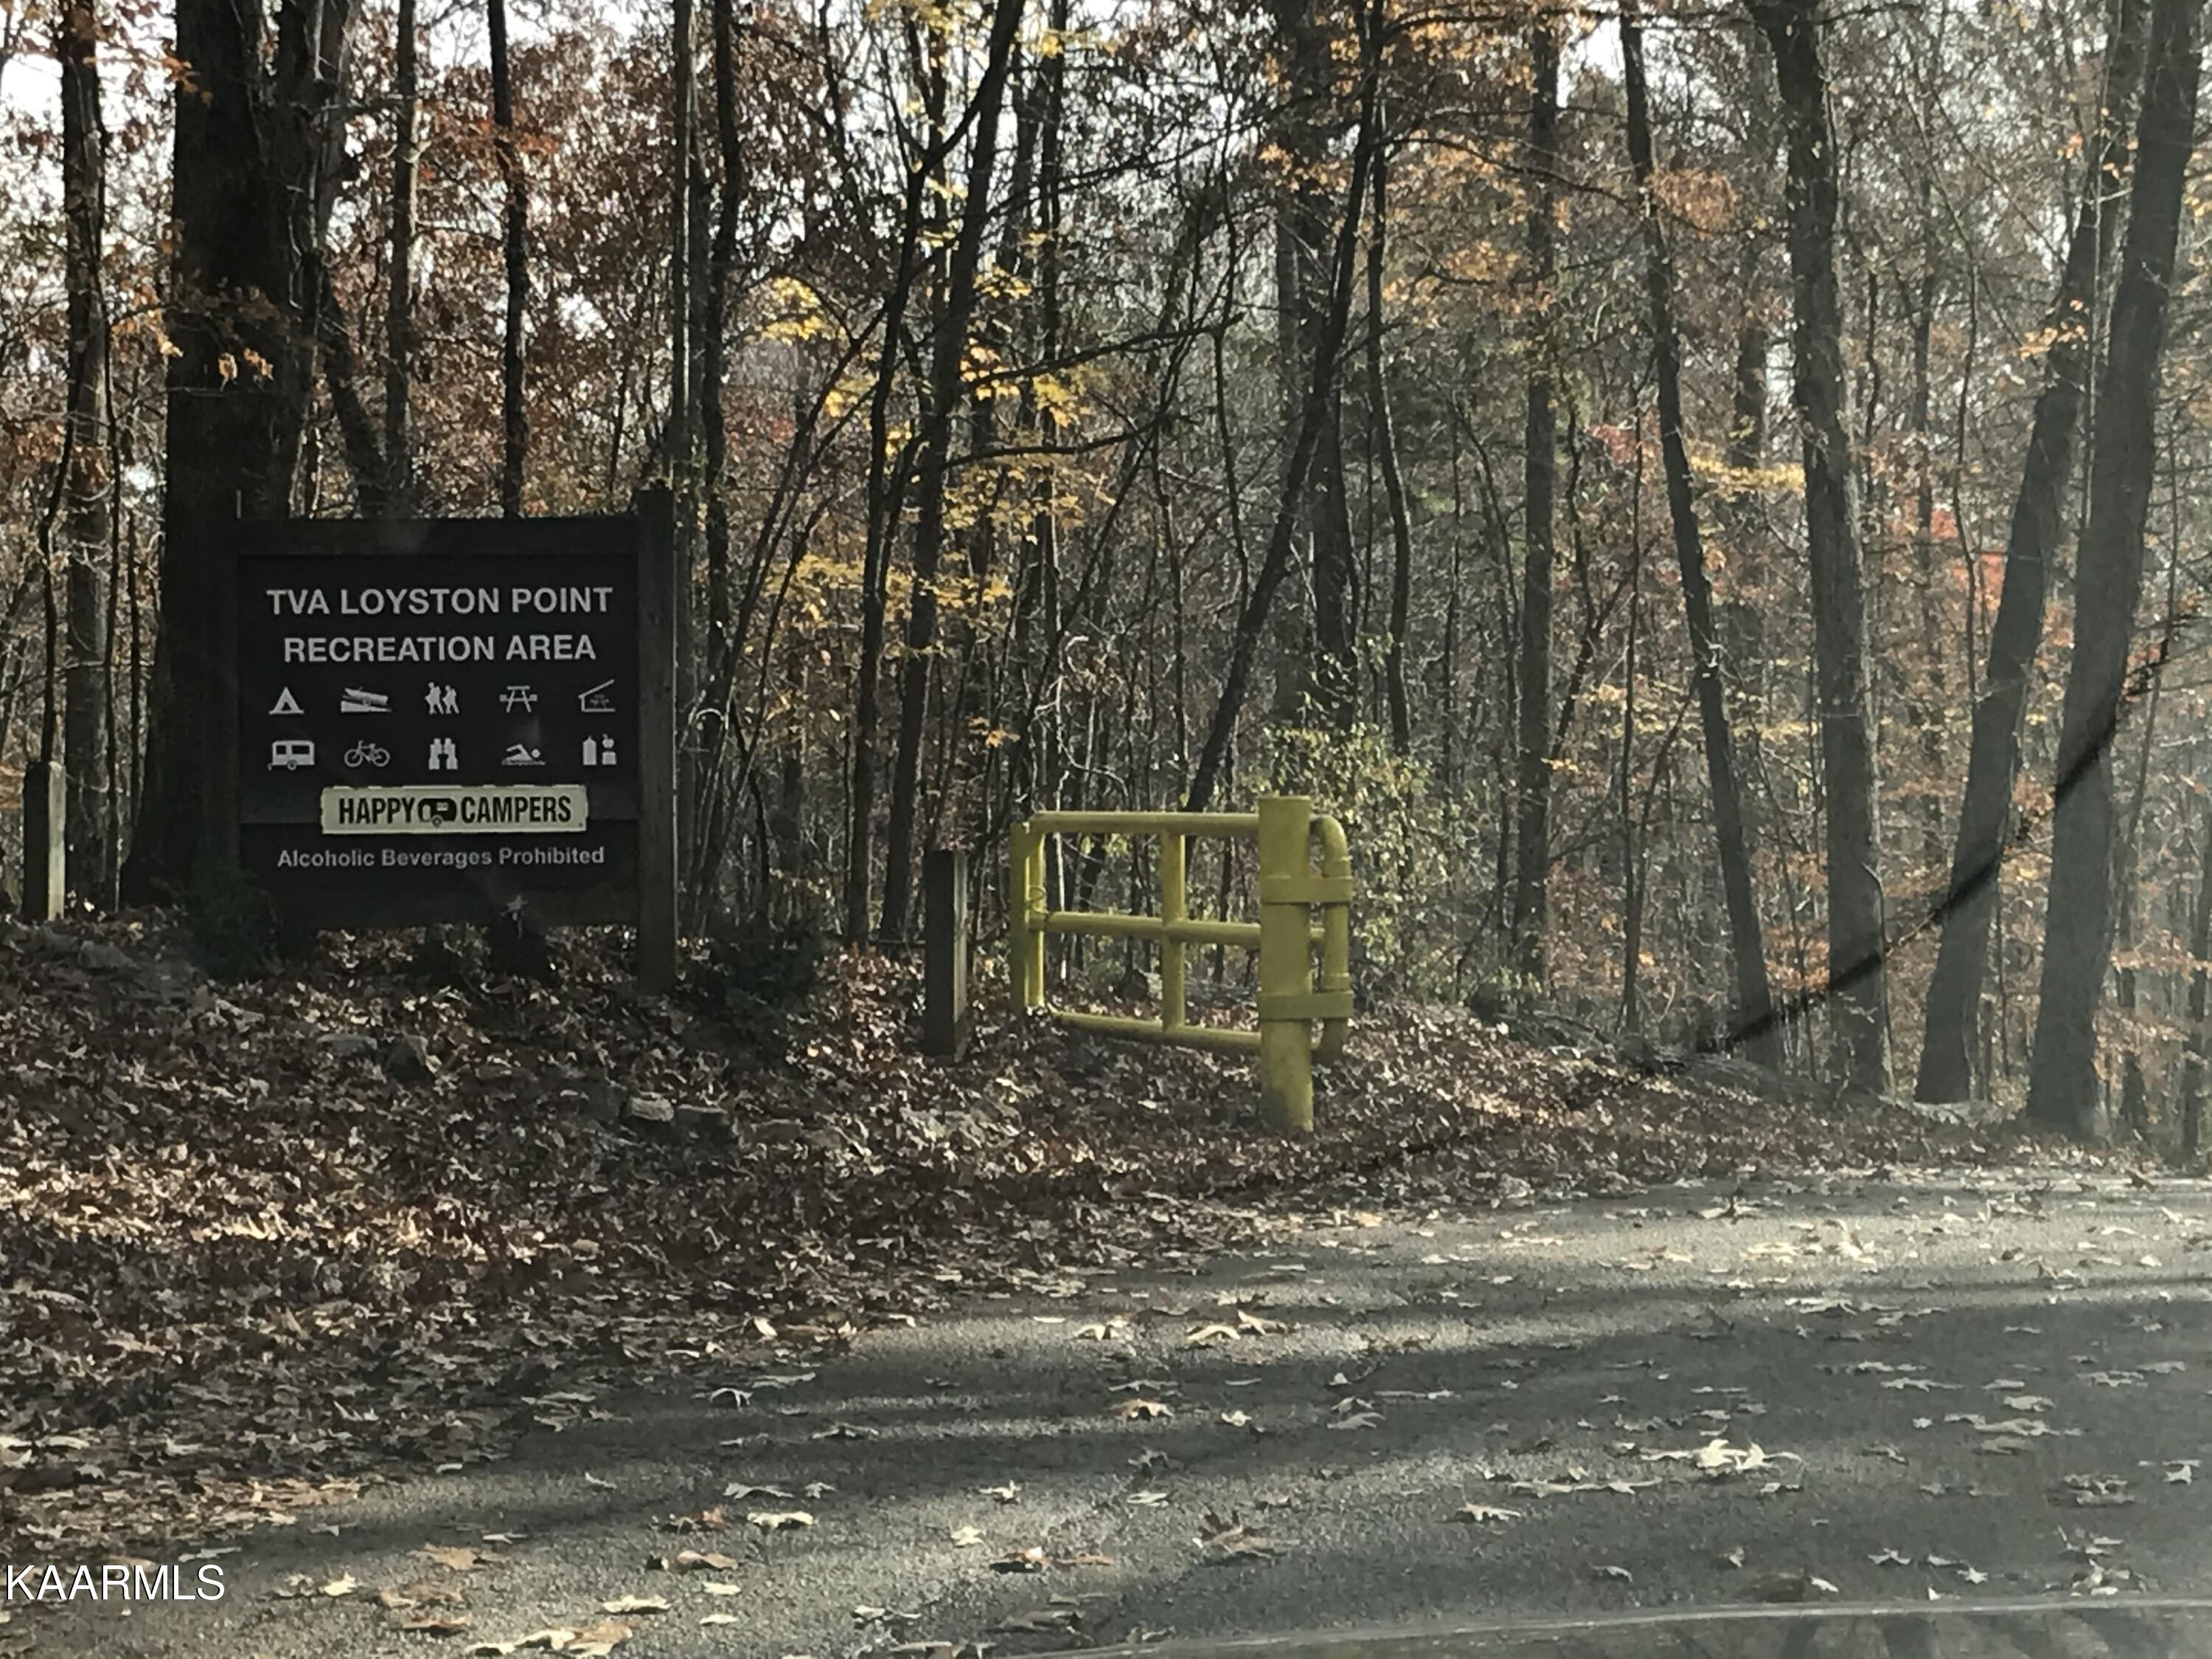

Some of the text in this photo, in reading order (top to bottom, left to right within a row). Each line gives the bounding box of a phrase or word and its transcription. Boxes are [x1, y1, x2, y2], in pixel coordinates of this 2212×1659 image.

[266, 587, 613, 616] TVA LOYSTON POINT
[284, 635, 597, 663] RECREATION AREA
[338, 796, 571, 825] HAPPY CAMPERS
[277, 846, 605, 869] Alcoholic Beverages Prohibited
